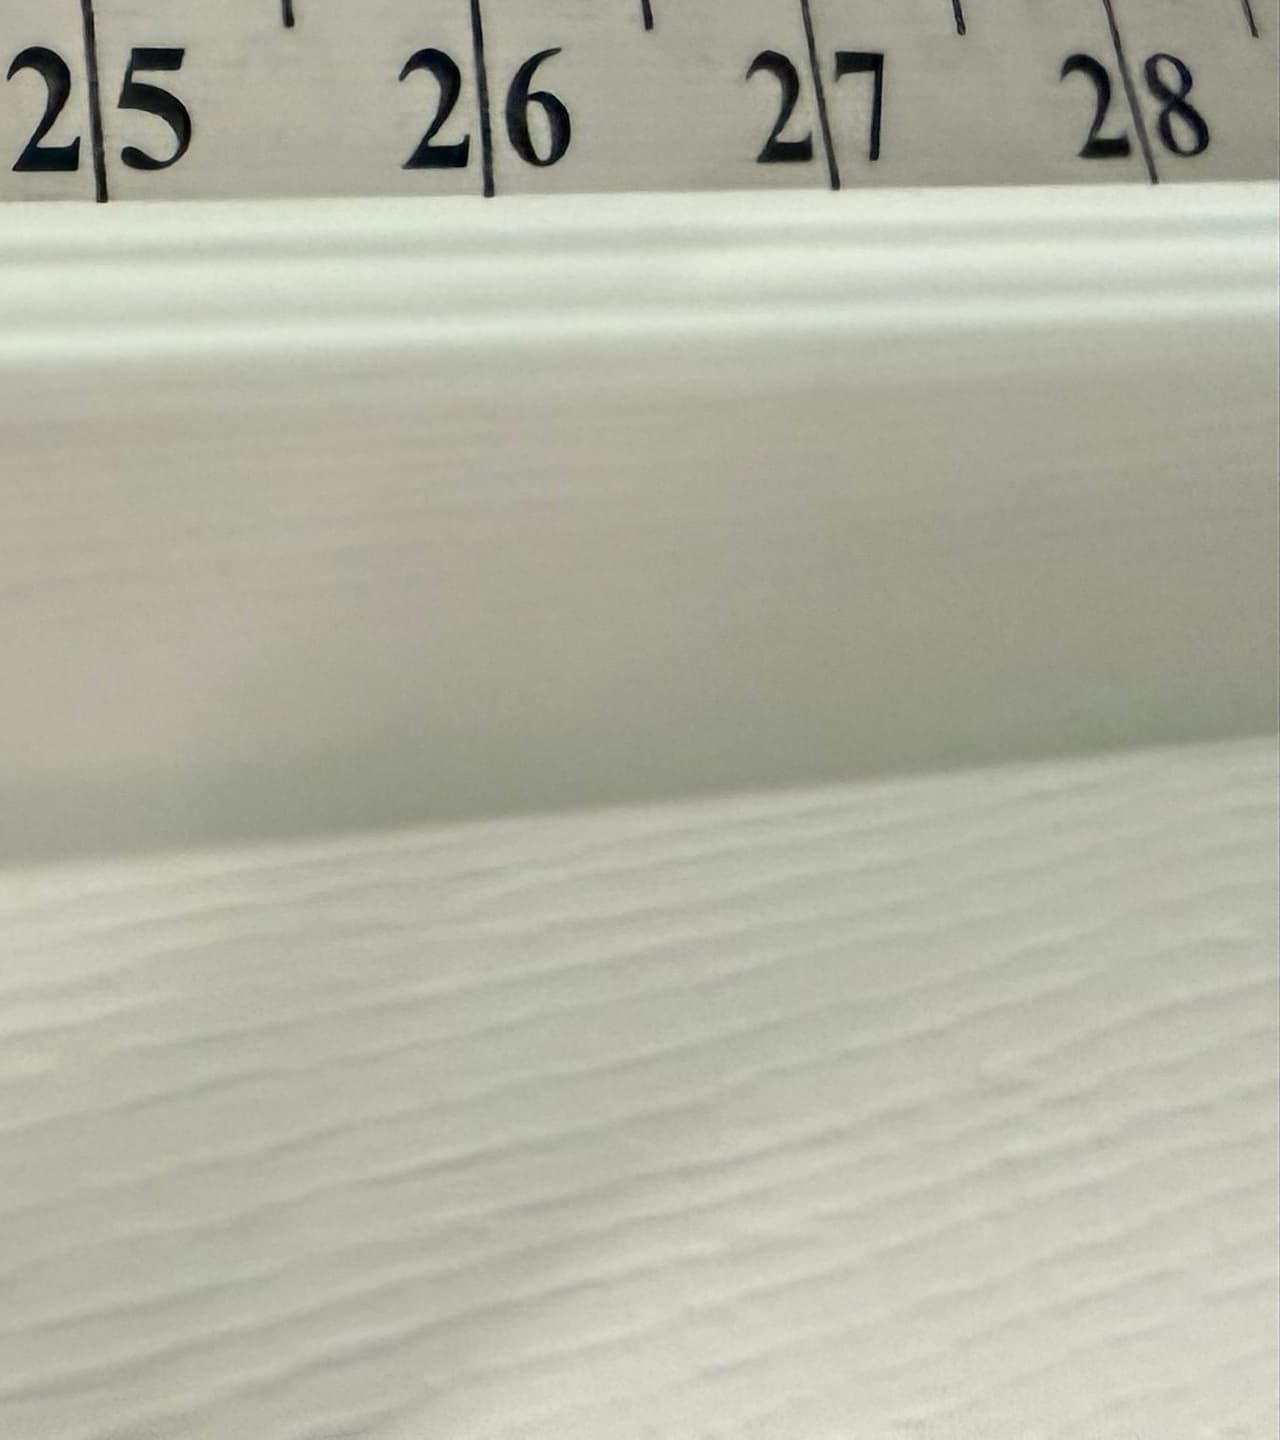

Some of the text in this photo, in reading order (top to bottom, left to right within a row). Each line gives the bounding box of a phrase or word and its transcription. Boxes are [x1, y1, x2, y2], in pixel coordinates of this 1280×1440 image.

[6, 45, 193, 172] 25
[398, 47, 572, 169] 26
[745, 49, 885, 165] 27
[1059, 52, 1212, 160] 28
